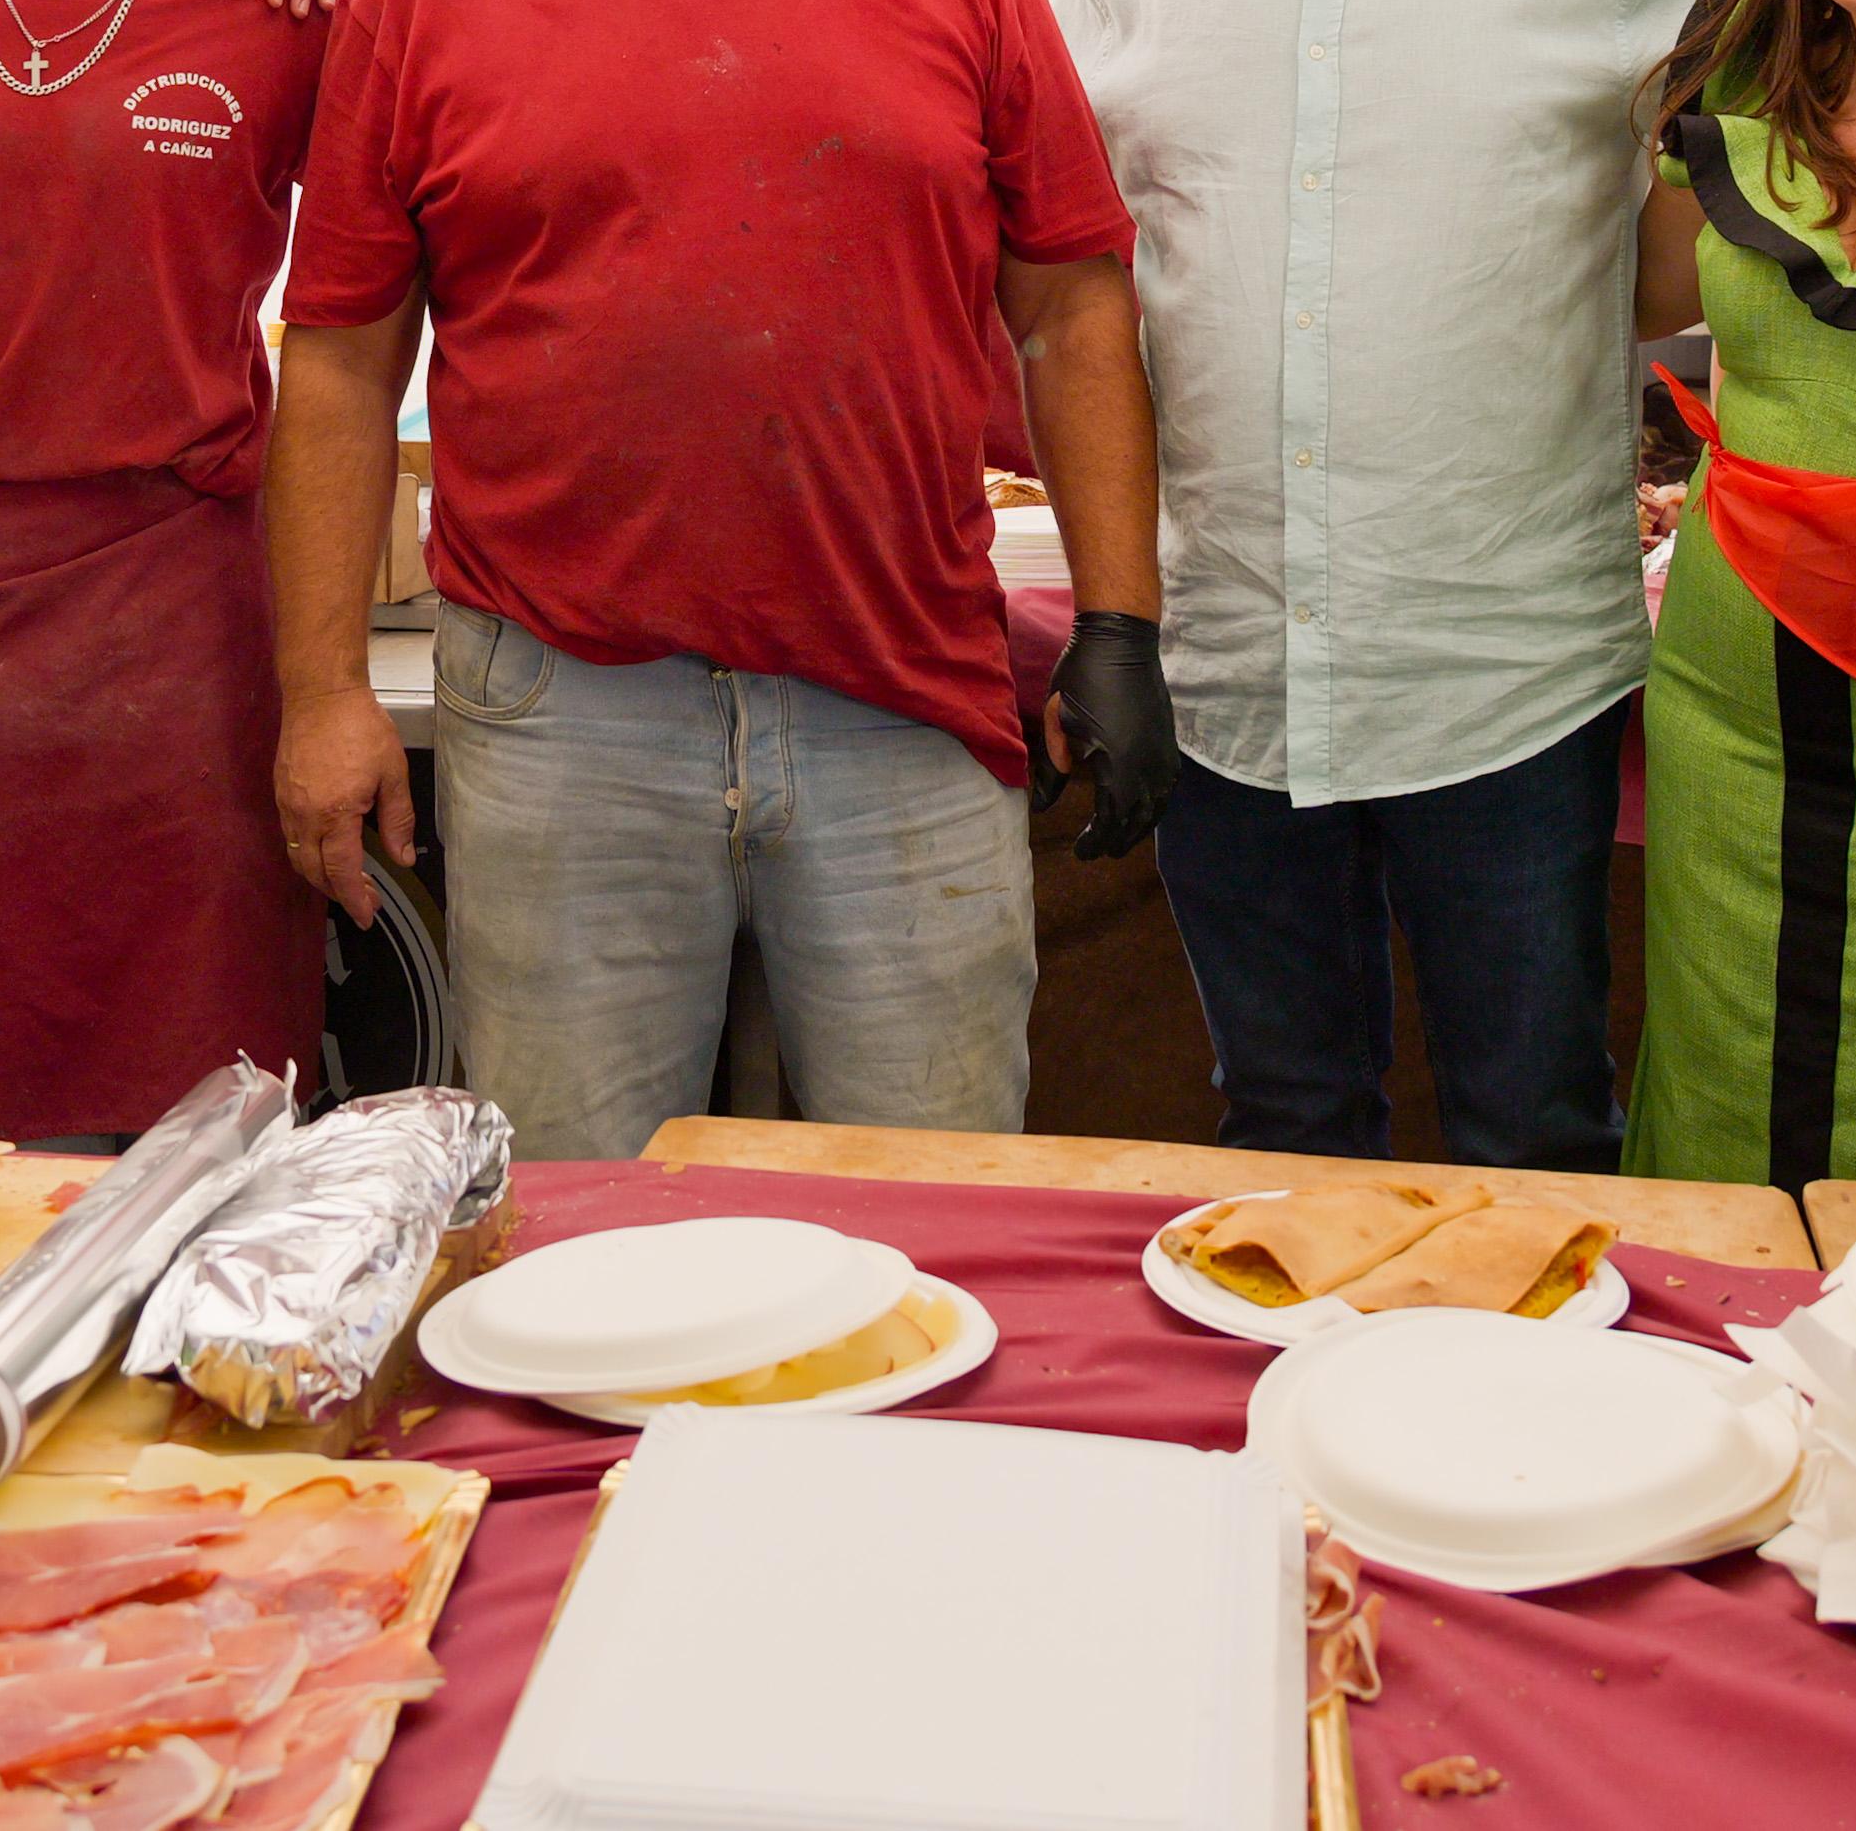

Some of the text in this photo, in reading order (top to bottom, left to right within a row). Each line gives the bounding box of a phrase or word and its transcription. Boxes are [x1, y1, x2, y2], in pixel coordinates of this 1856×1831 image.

[123, 72, 243, 123] DISTRIBUCIONES
[131, 114, 232, 140] RODRIGUEZ
[143, 140, 213, 160] A CAÑIZA
